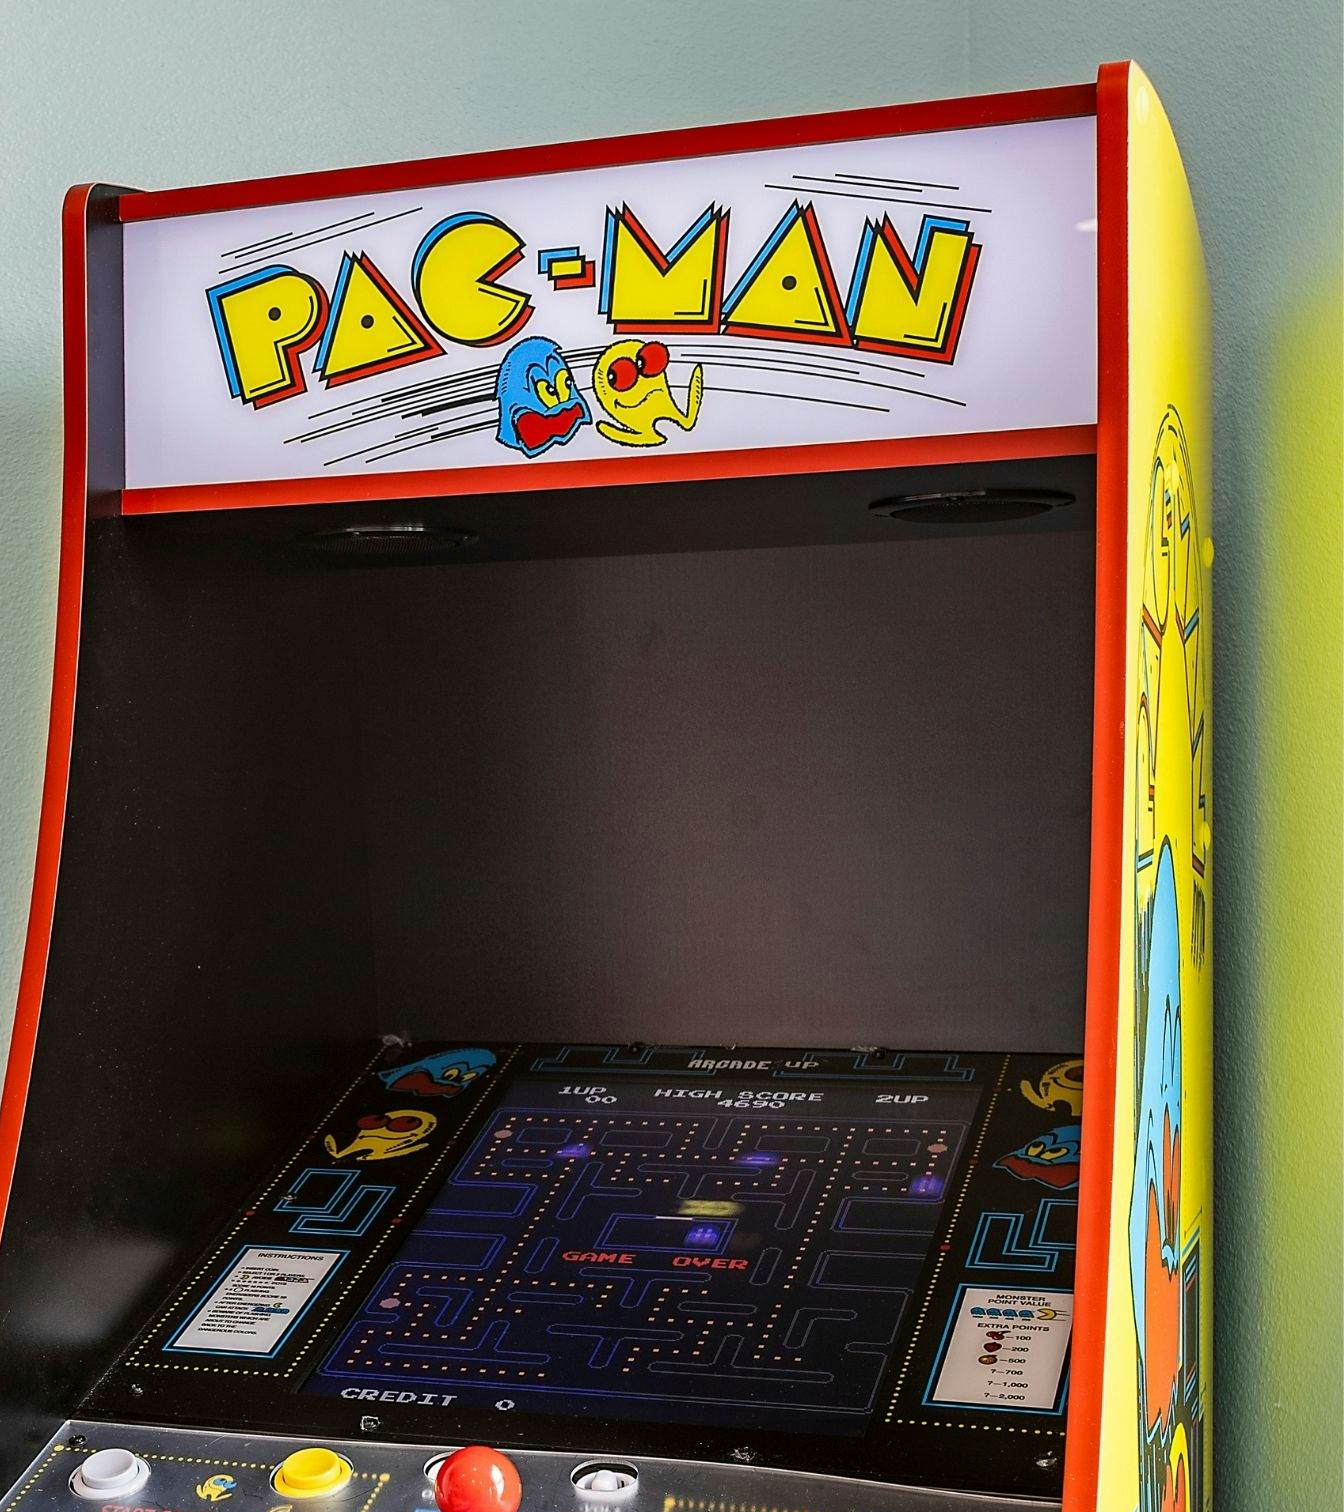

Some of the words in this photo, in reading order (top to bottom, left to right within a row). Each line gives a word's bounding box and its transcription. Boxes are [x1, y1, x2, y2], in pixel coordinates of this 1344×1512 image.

[204, 198, 982, 409] PAC-MAN
[688, 1059, 773, 1071] ARCADE
[558, 1086, 608, 1095] 1UP
[654, 1088, 723, 1099] HIGH
[738, 1091, 824, 1102] SCORE
[875, 1094, 929, 1104] 2UP
[716, 1099, 786, 1109] 4690
[561, 1250, 638, 1265] GAME
[672, 1256, 750, 1270] OVER
[1012, 1324, 1050, 1332] POINTS
[340, 1387, 457, 1407] CREDIT
